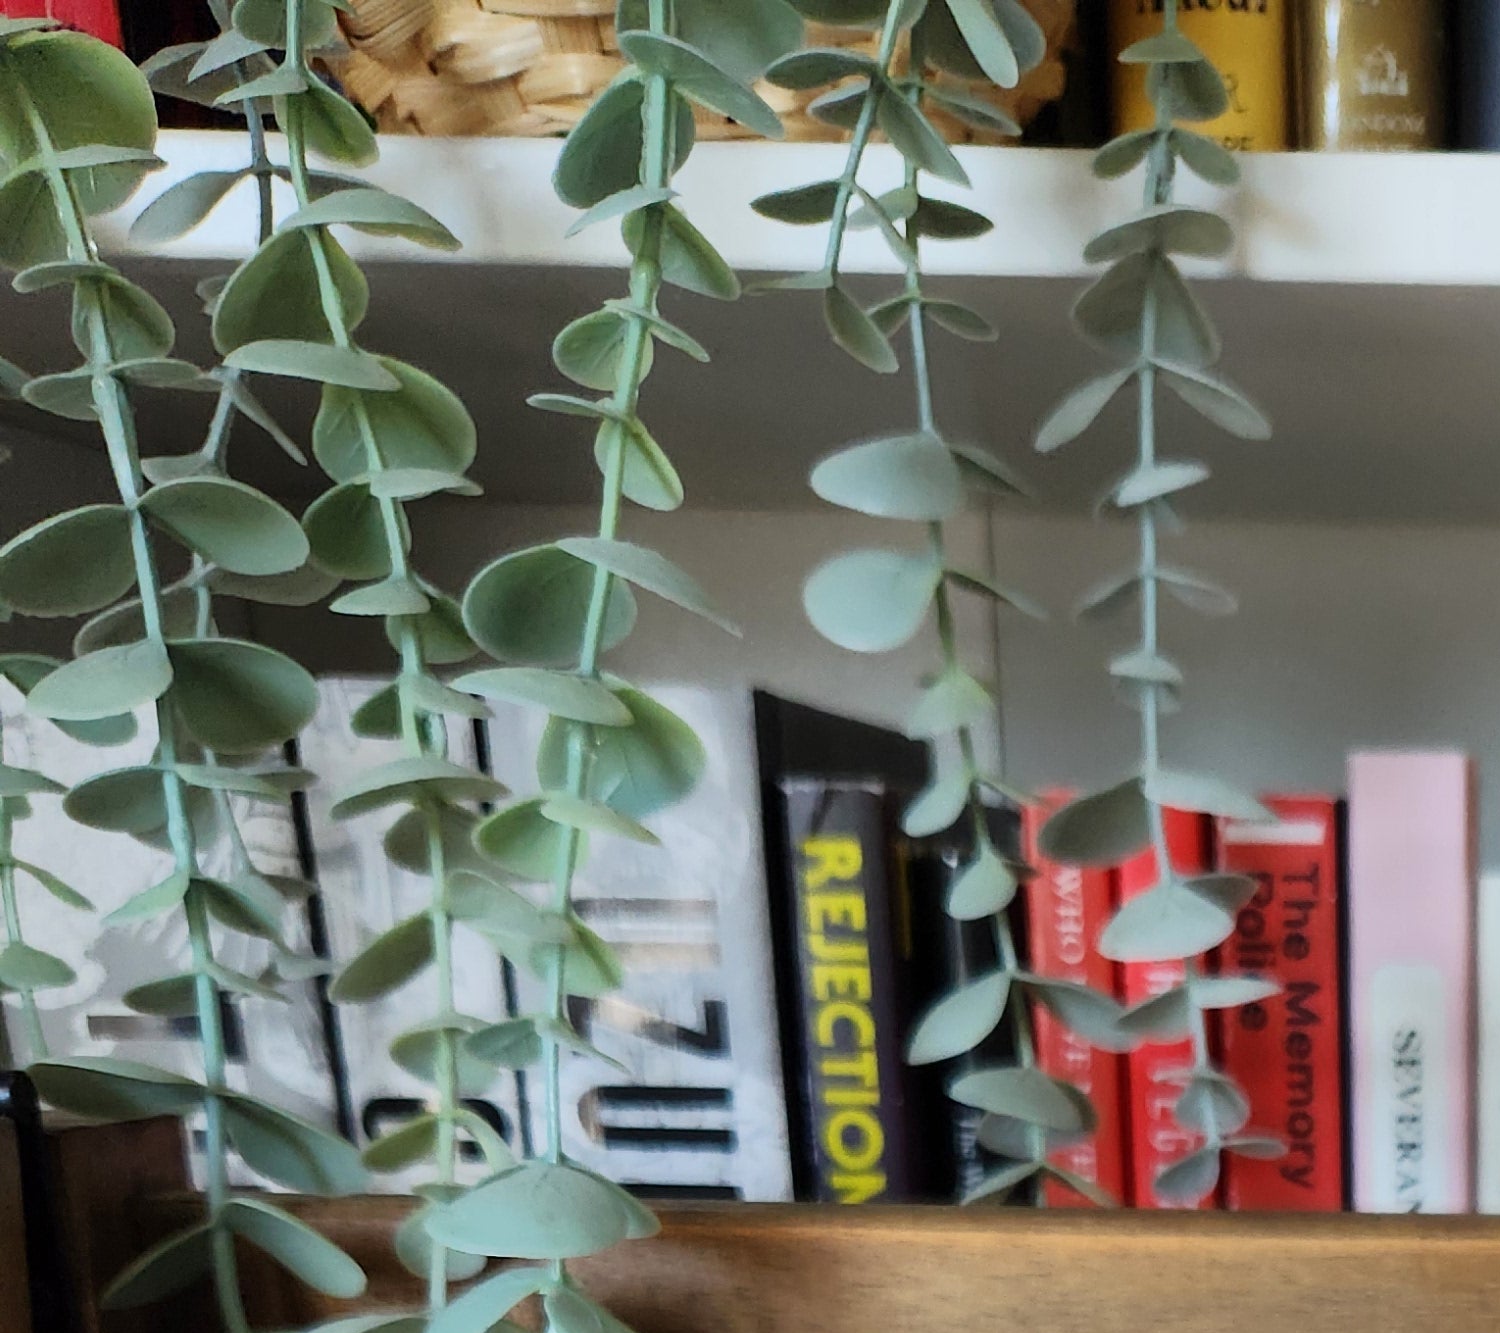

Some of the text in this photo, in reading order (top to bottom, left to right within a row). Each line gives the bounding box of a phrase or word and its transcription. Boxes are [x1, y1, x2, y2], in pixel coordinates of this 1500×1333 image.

[566, 898, 741, 1201] UZU
[802, 834, 888, 1204] REJECTION
[1236, 872, 1276, 1032] Polie
[1279, 861, 1323, 1192] The Memory
